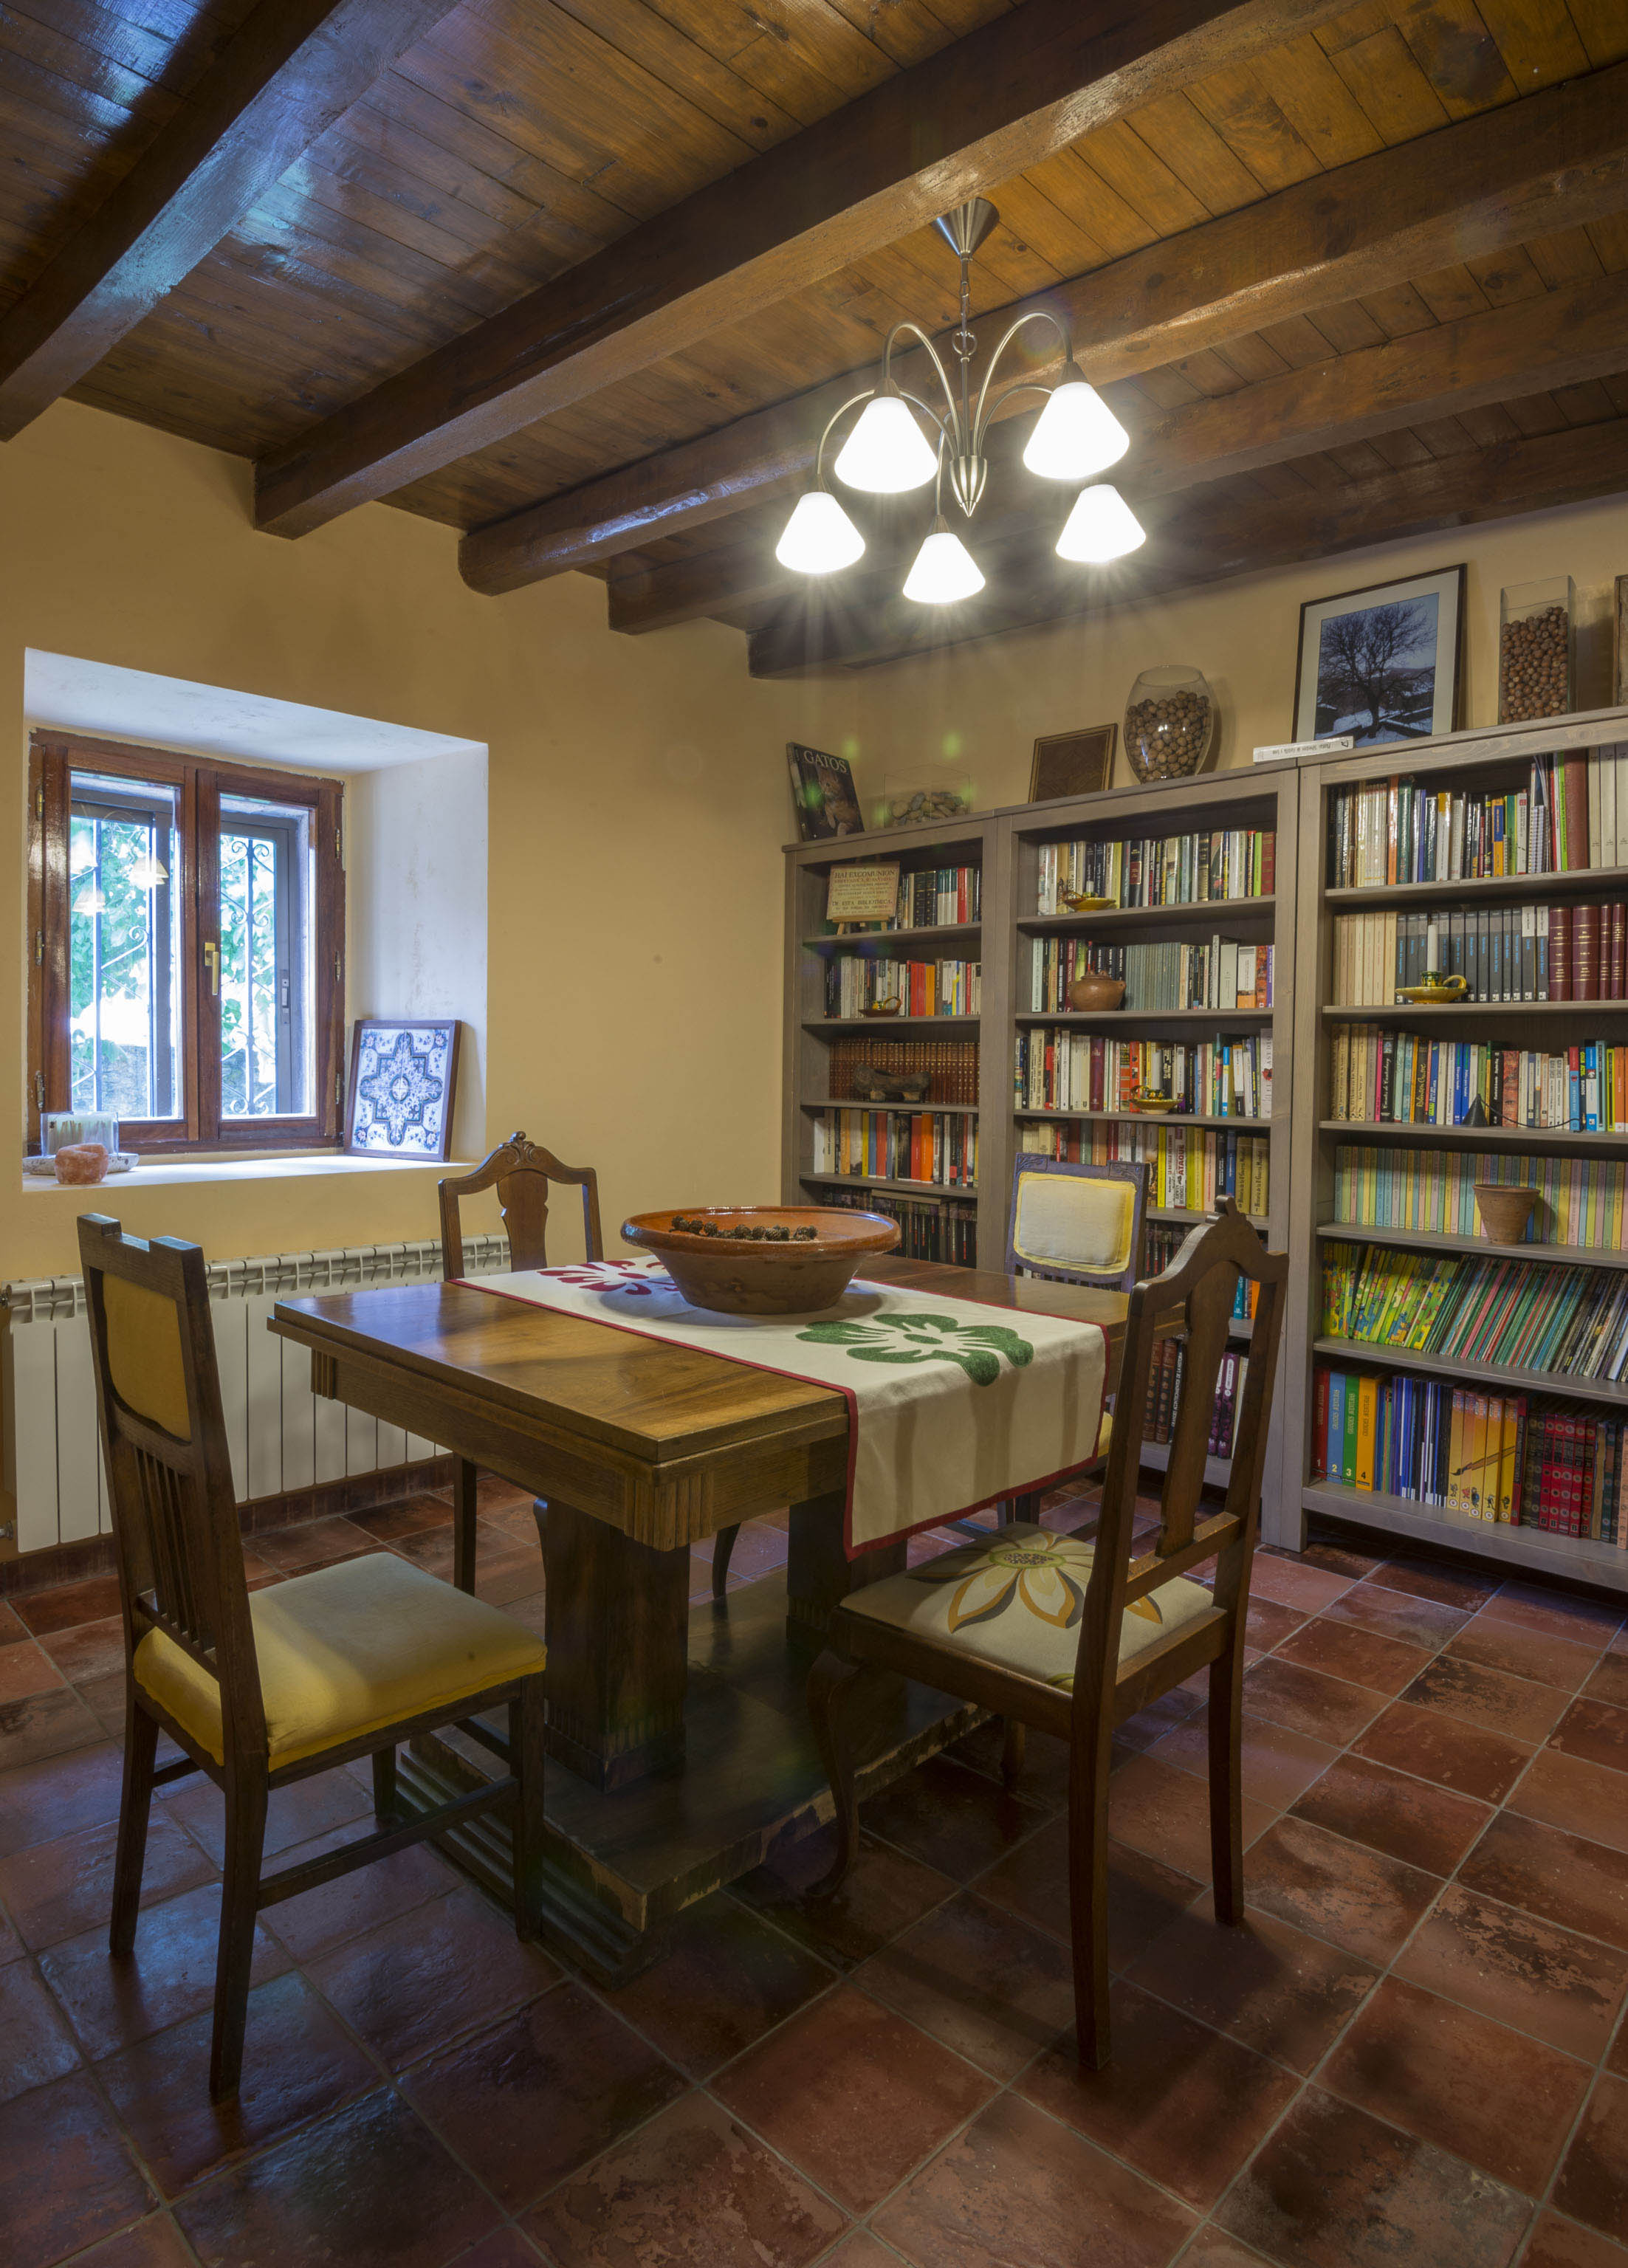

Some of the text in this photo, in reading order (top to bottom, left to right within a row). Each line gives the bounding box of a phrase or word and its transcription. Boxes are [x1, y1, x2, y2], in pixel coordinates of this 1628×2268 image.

[803, 750, 847, 773] GATOS
[1416, 1084, 1424, 1107] Robinson
[1317, 1458, 1321, 1467] 1
[1332, 1464, 1338, 1473] 2
[1346, 1468, 1352, 1477] 3
[1361, 1471, 1366, 1480] 4
